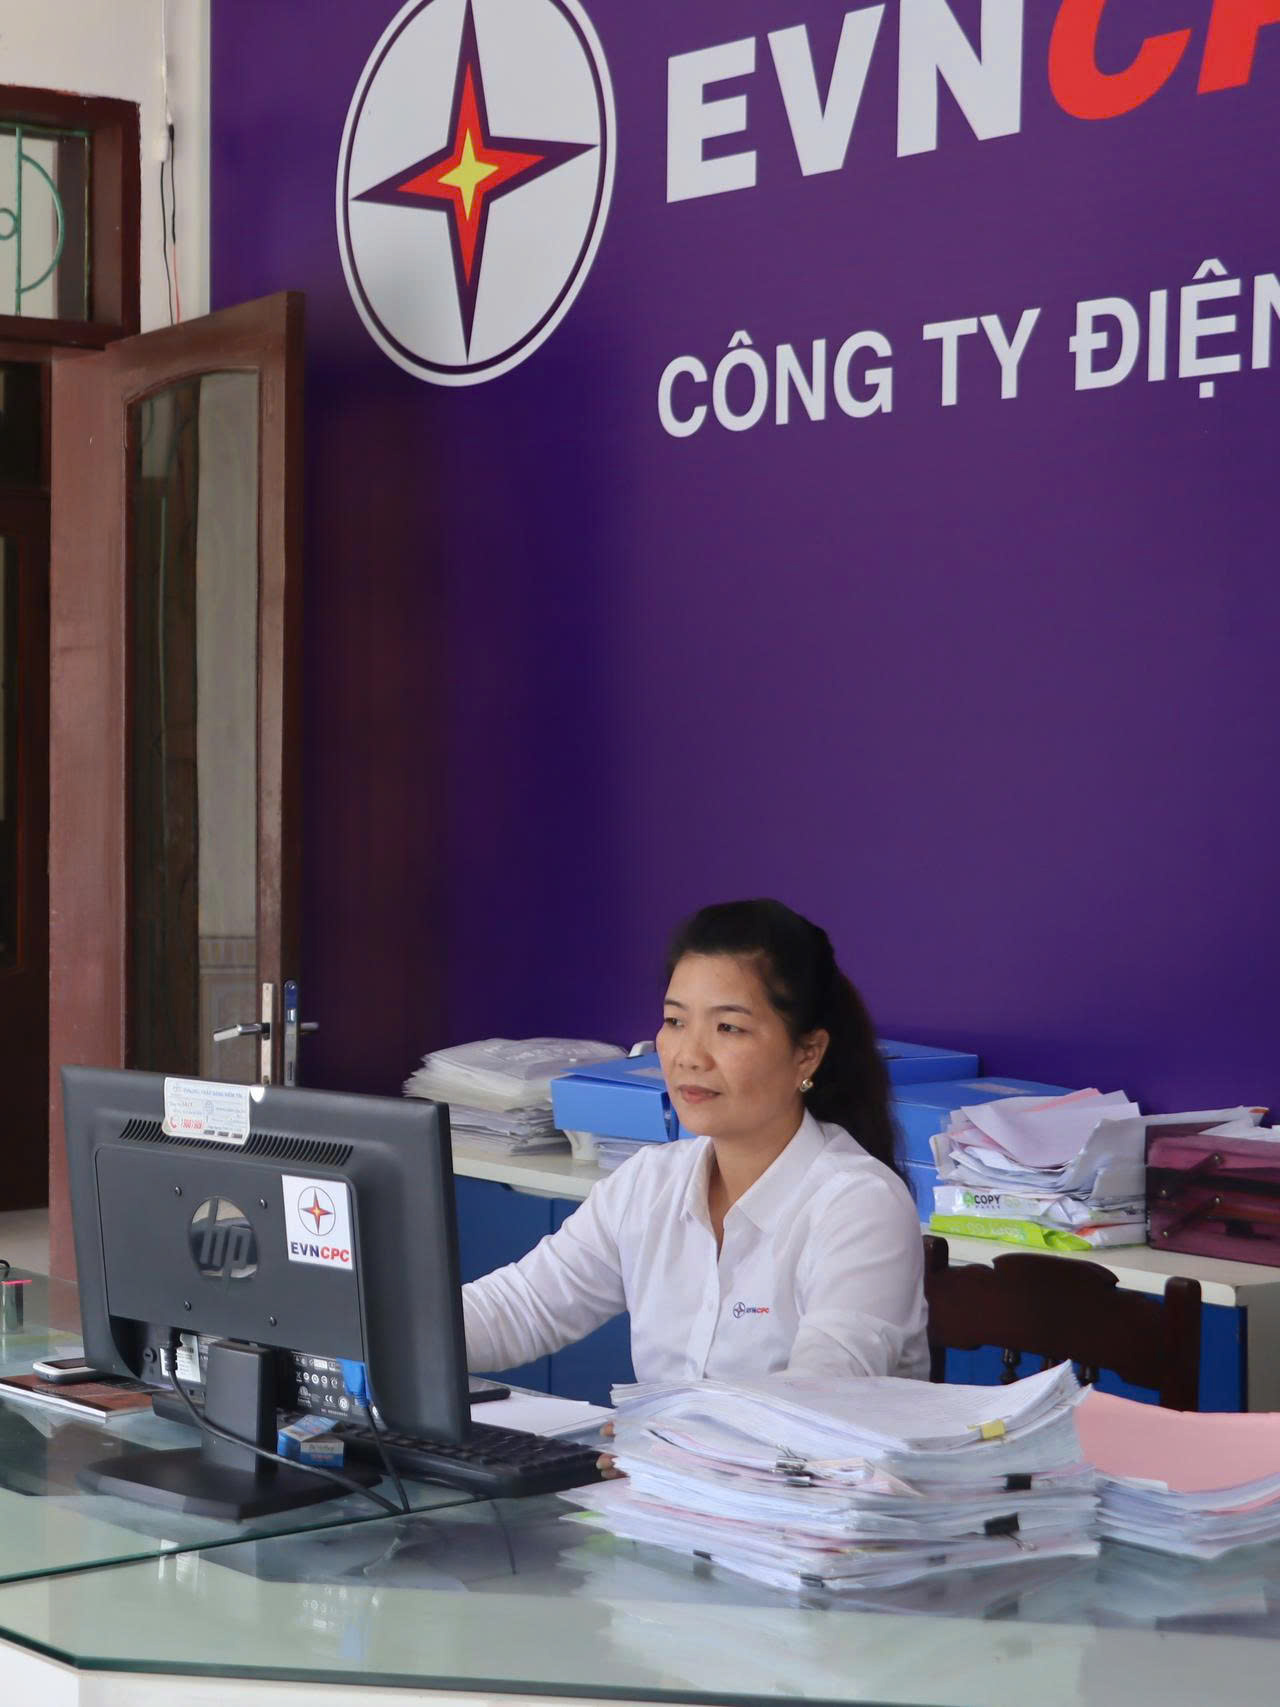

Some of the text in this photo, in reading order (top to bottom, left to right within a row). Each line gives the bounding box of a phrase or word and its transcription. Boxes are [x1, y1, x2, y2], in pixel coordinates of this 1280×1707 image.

[657, 330, 893, 438] CÔNG
[923, 308, 1041, 407] TY
[974, 1194, 1001, 1205] COPY
[290, 1241, 350, 1263] EVNCPC
